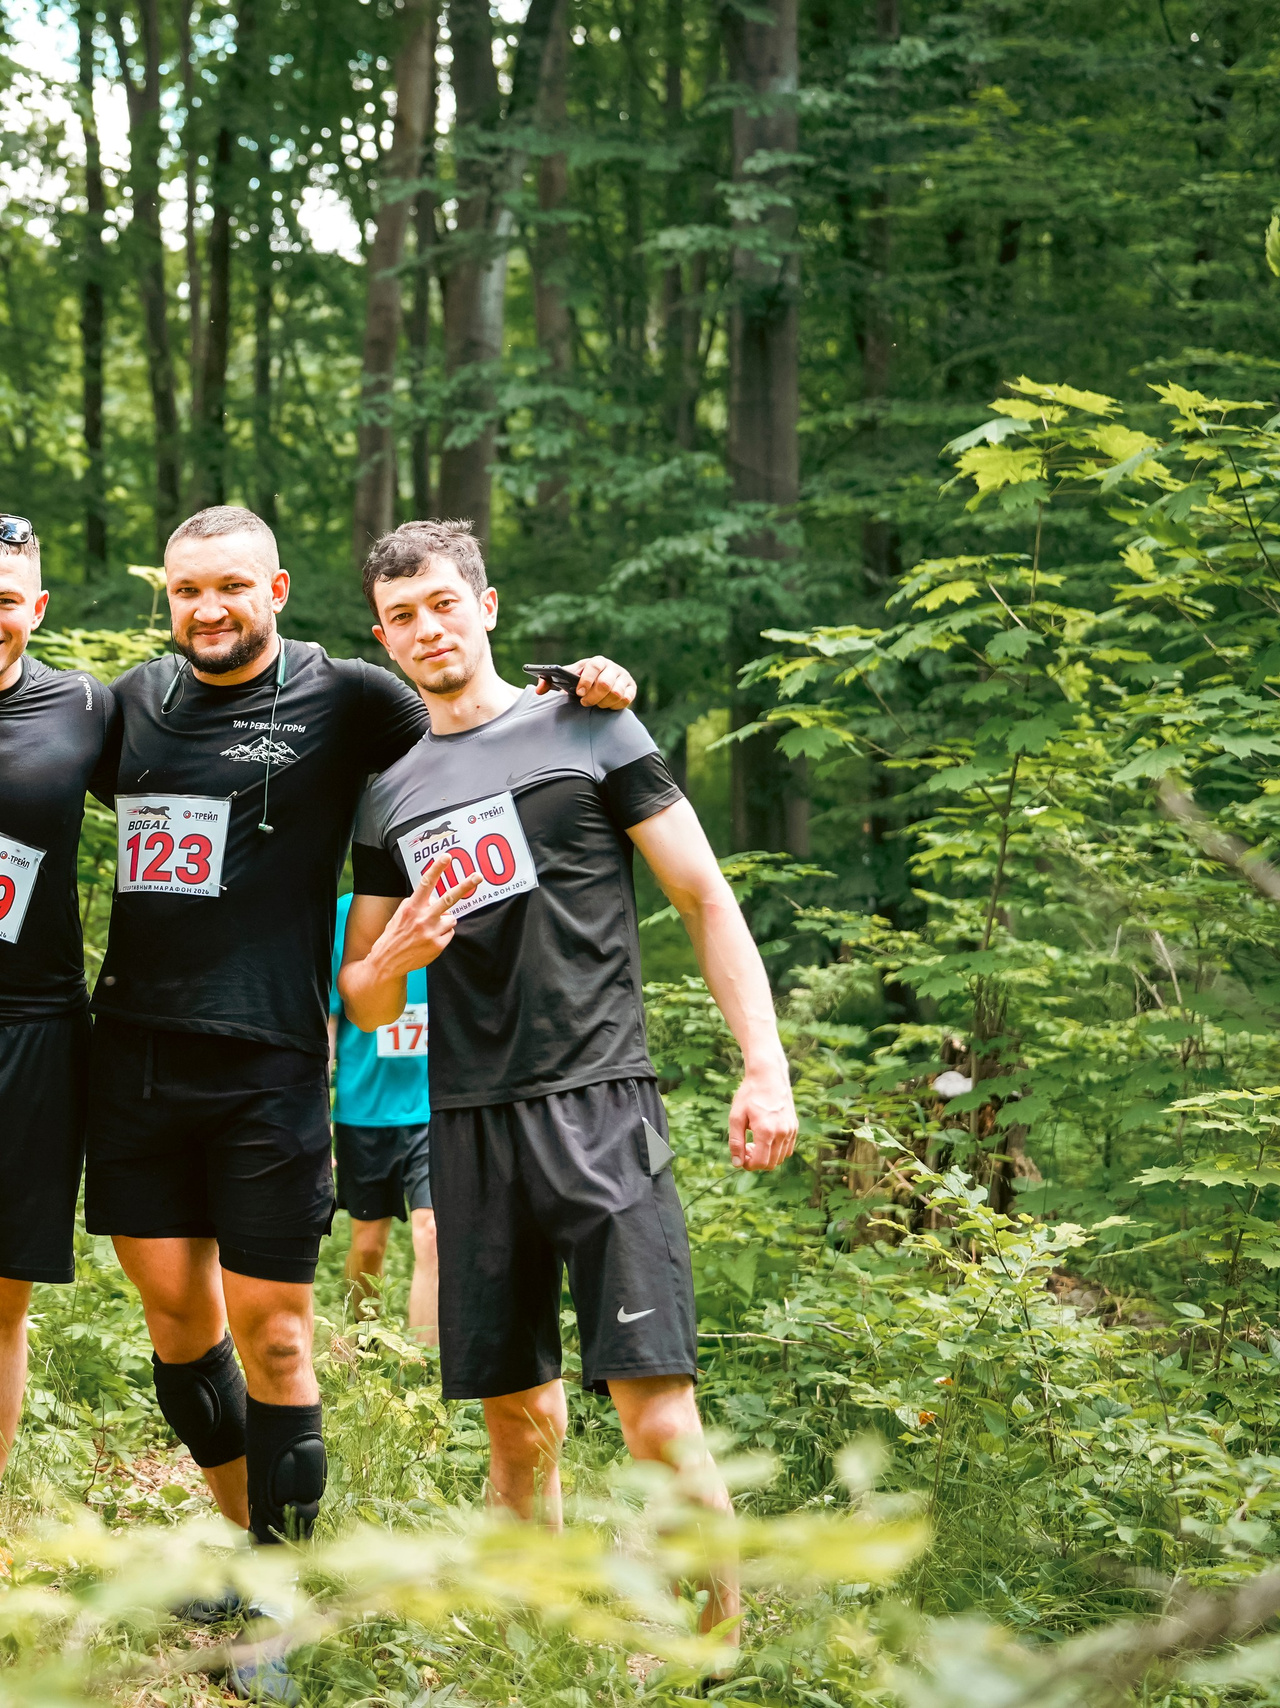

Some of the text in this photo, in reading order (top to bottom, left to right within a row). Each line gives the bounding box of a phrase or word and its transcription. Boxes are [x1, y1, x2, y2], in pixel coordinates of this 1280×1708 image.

[84, 681, 93, 711] Reebok
[232, 720, 249, 729] ТАМ
[282, 724, 306, 733] ГОРЫ
[127, 820, 171, 831] BOGAL
[126, 831, 213, 885] 123
[413, 834, 461, 864] BOGAL
[153, 885, 192, 893] МАРАФОН
[472, 886, 511, 905] МАРАФОН
[386, 1023, 428, 1050] 17
